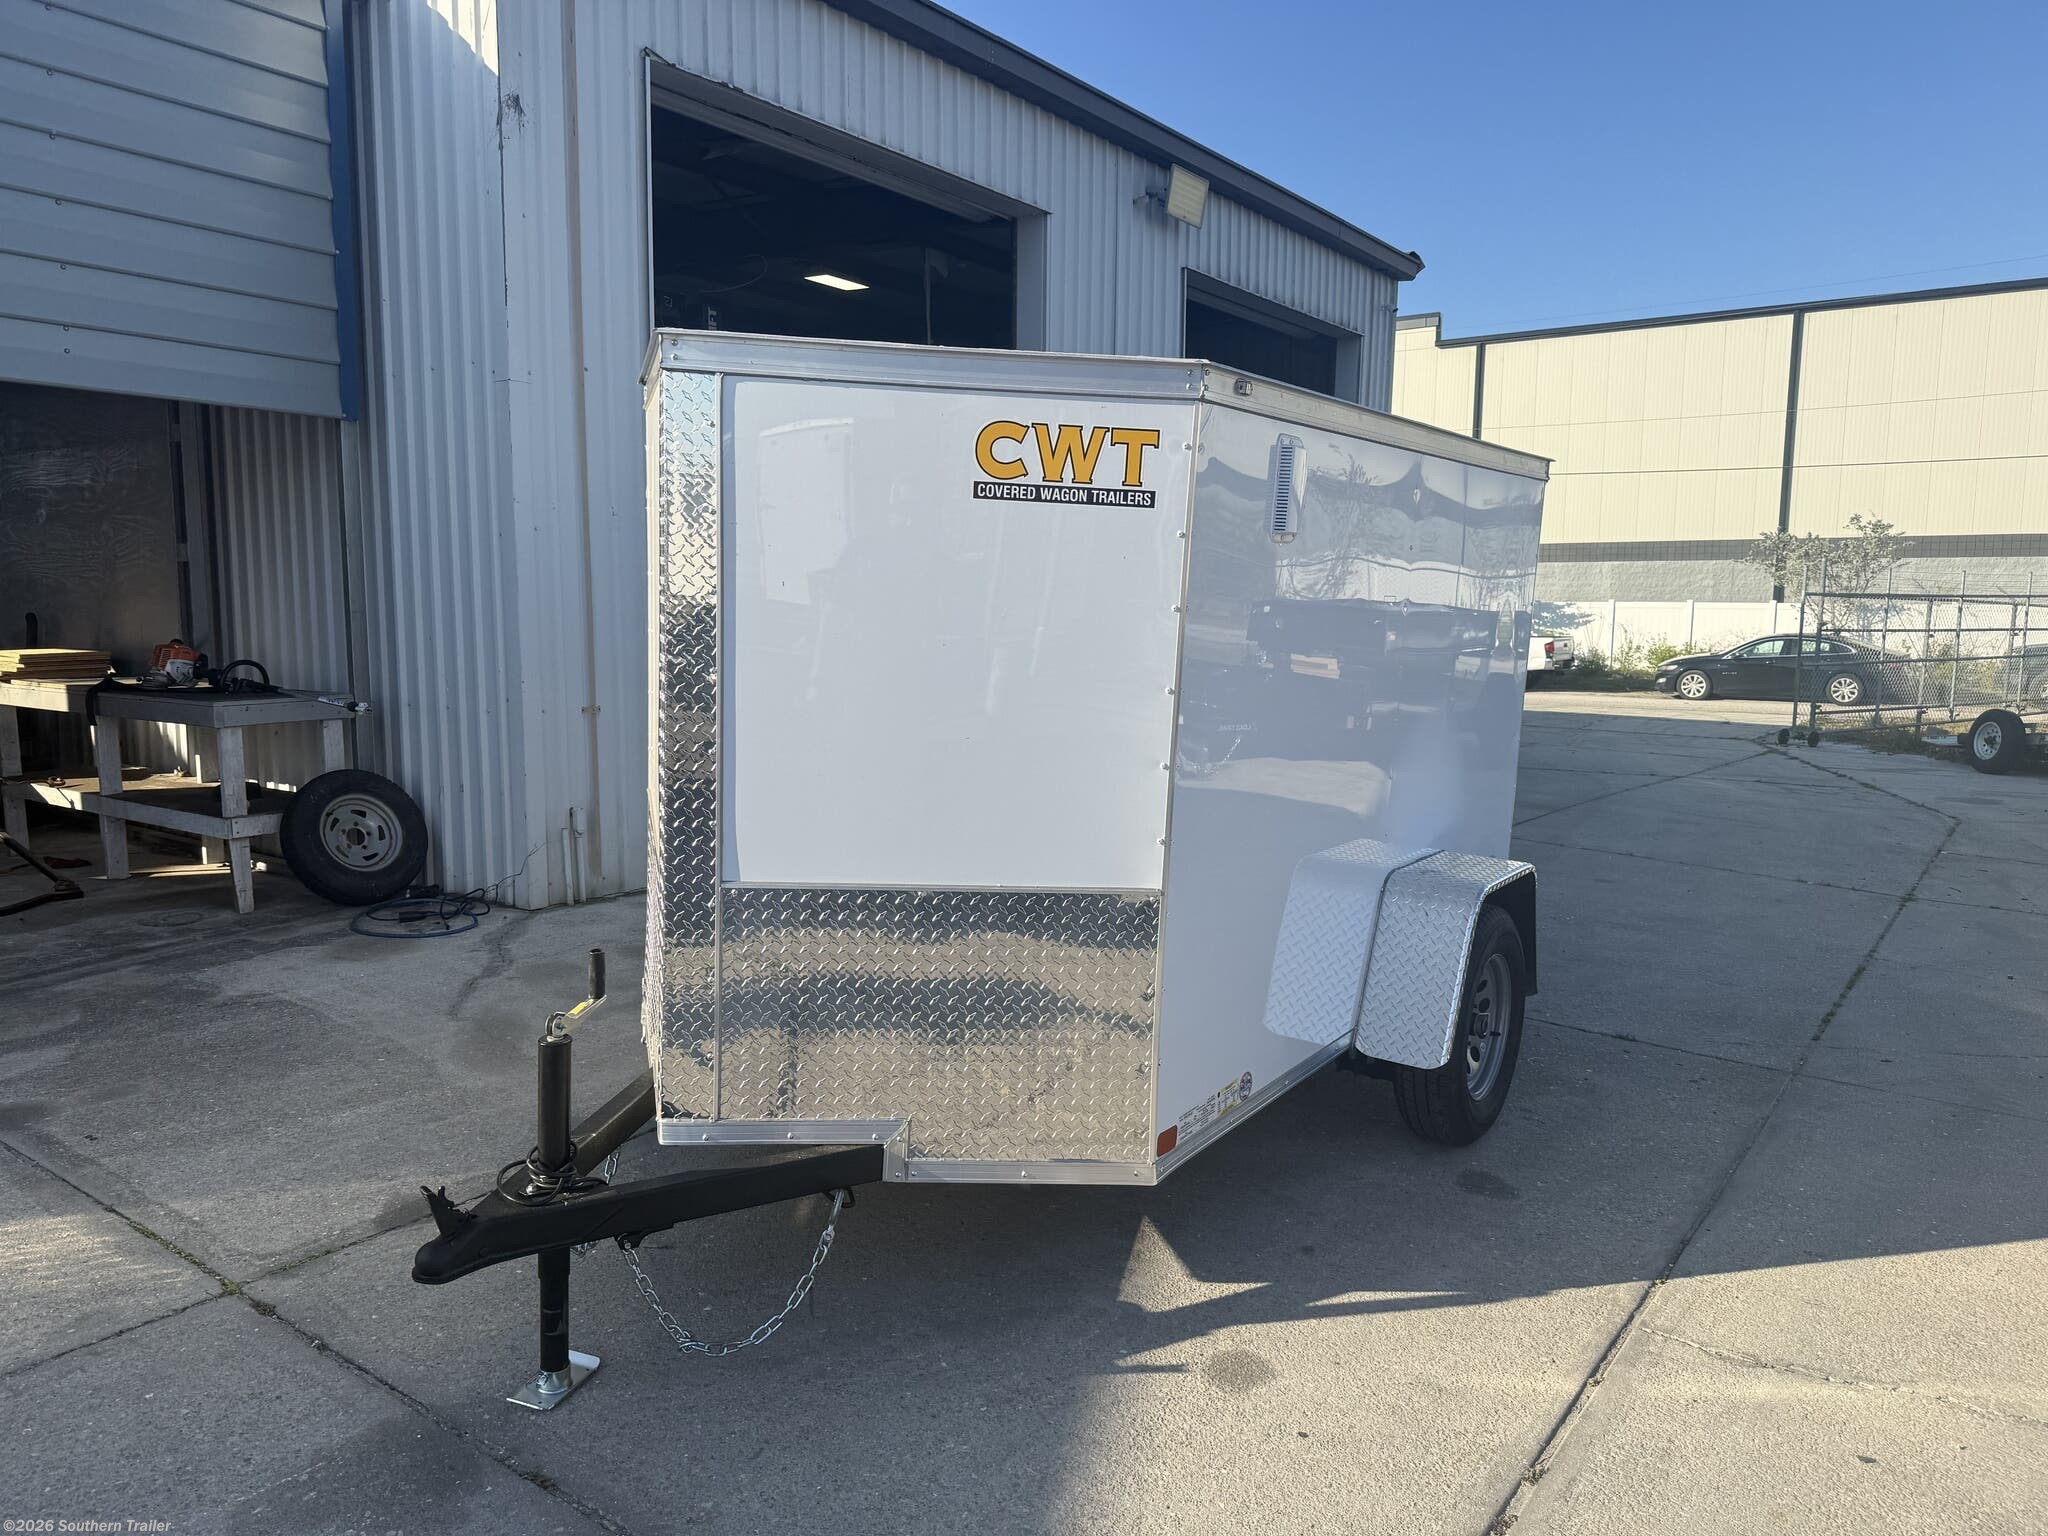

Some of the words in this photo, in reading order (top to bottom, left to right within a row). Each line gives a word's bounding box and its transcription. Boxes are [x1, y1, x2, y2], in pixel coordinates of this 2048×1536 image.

[975, 420, 1160, 487] CWT
[977, 483, 1036, 500] COVERED
[1040, 487, 1087, 503] WAGON
[1092, 490, 1151, 506] TRAILERS
